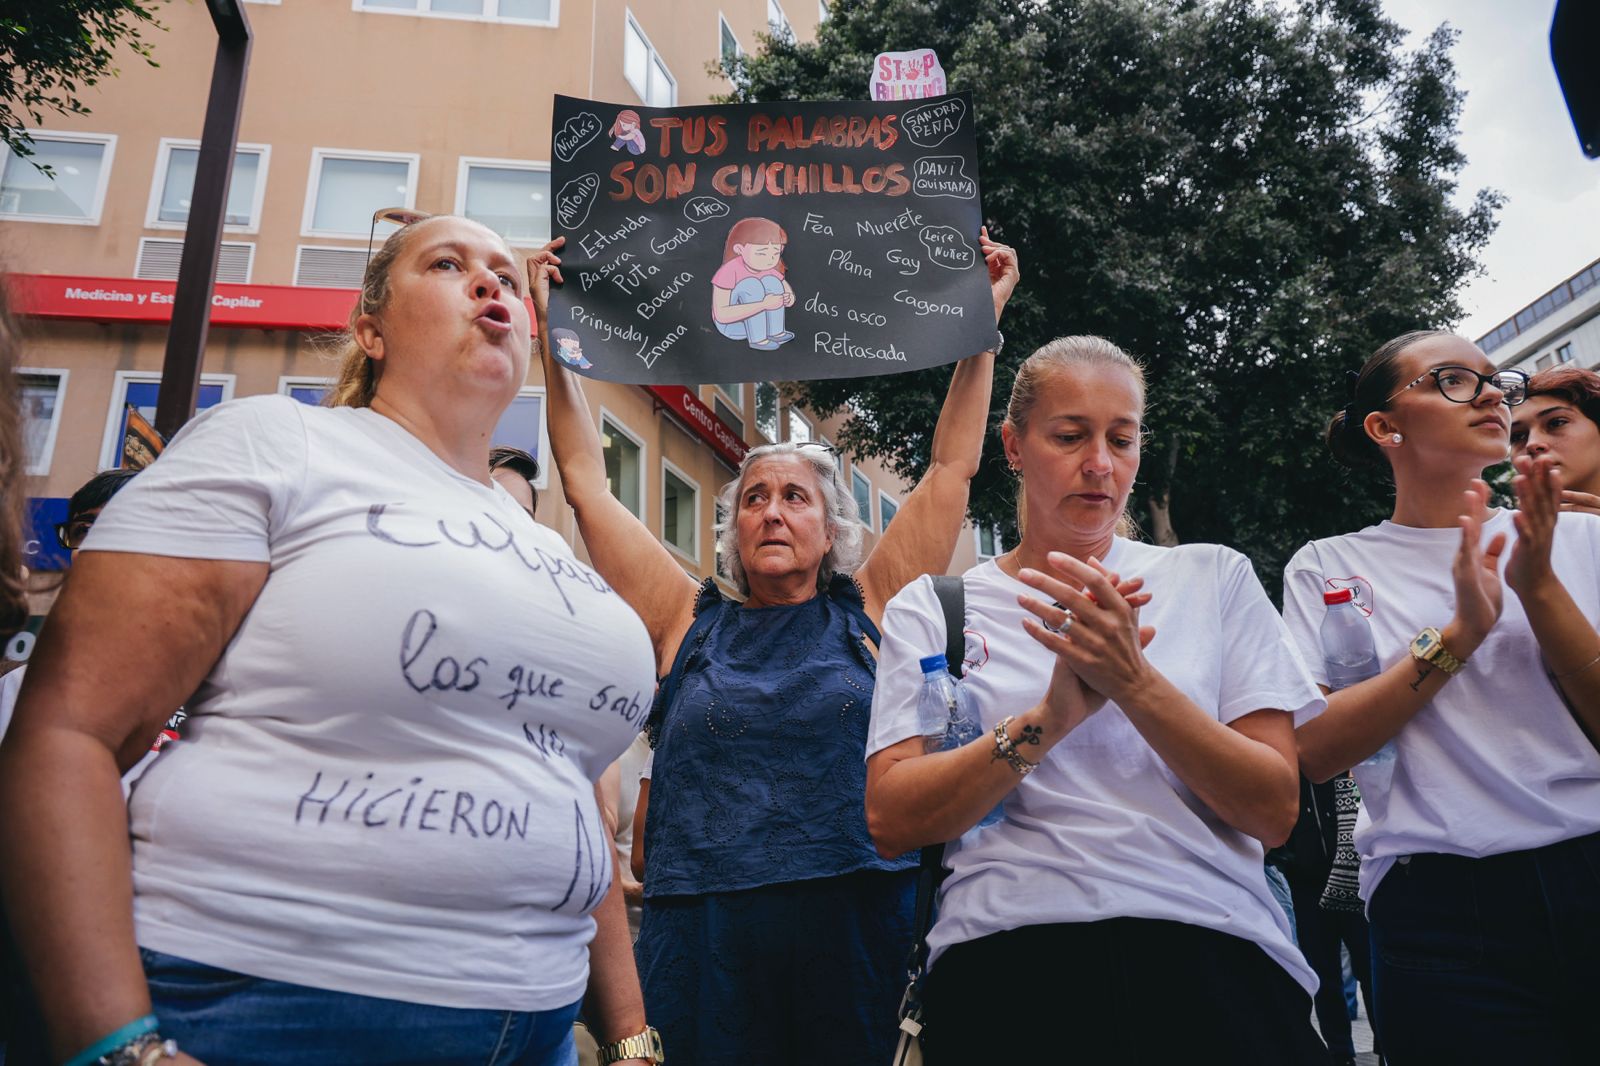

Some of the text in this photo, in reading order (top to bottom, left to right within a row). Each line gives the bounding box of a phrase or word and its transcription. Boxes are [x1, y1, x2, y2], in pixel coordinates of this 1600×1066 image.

[906, 101, 960, 126] SANDRA
[912, 118, 954, 139] PEÑA
[556, 119, 596, 157] Nicolás
[650, 112, 899, 157] TUS PALABRAS
[608, 161, 911, 204] SON CUCHILLOS
[650, 225, 699, 255] Gorda
[802, 212, 834, 237] Fea
[925, 229, 955, 243] Leire
[580, 251, 636, 292] Basura
[828, 249, 873, 279] Plana
[886, 249, 921, 276] Gay
[64, 287, 134, 303] Medicina
[137, 293, 147, 305] y
[211, 294, 263, 309] Capilar
[636, 270, 695, 320] Basura
[804, 291, 887, 327] das asco
[893, 289, 964, 318] Cagona
[570, 305, 643, 342] Pringada
[635, 322, 688, 370] Enana
[814, 331, 908, 362] Retrasada
[683, 393, 744, 459] Centro Capilar
[499, 664, 565, 710] que
